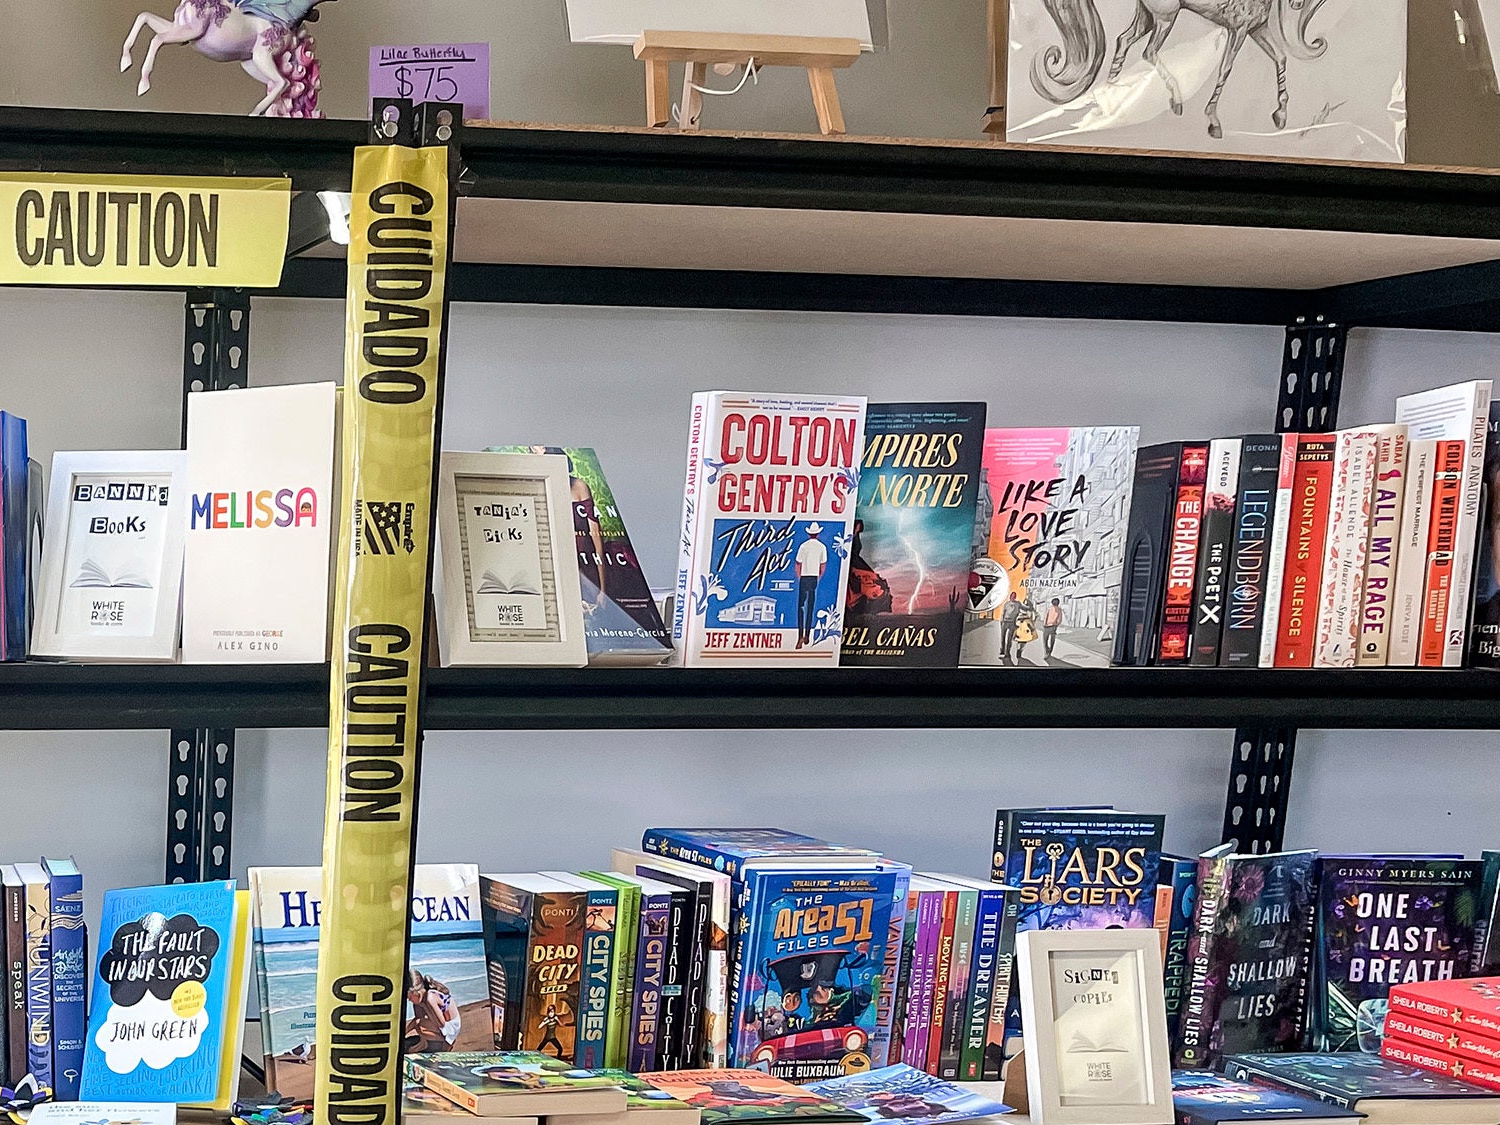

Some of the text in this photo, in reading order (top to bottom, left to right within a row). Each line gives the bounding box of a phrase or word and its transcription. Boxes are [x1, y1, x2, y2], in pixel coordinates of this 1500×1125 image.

[380, 47, 466, 60] Lilac Butterfly
[395, 66, 458, 101] $75
[15, 190, 220, 268] CAUTION
[358, 181, 434, 405] CUIDADO
[721, 414, 857, 467] COLTON
[191, 487, 316, 530] MELISSA
[718, 473, 848, 513] GENTRY'S
[873, 474, 968, 509] NORTE
[999, 474, 1087, 514] LIKE A
[1003, 509, 1078, 543] LOVE
[1170, 501, 1199, 589] THE CHANGE
[1230, 490, 1269, 630] LEGENDBORN
[1363, 490, 1397, 634] ALL MY RAGE
[217, 641, 279, 651] ALEX GINO
[704, 632, 782, 648] JEFF ZENTNER
[340, 623, 411, 823] CAUTION
[834, 899, 873, 944] 51
[1358, 893, 1409, 919] ONE
[158, 930, 205, 956] FAULT
[533, 945, 578, 962] DEAD
[1371, 927, 1437, 952] LAST
[109, 954, 207, 981] IN OUR STARS
[539, 963, 578, 982] CITY
[1350, 959, 1453, 984] BREATH
[586, 935, 609, 1041] CITY SPIES
[968, 955, 995, 1050] DREAMER
[112, 1019, 197, 1042] JOHN GREEN
